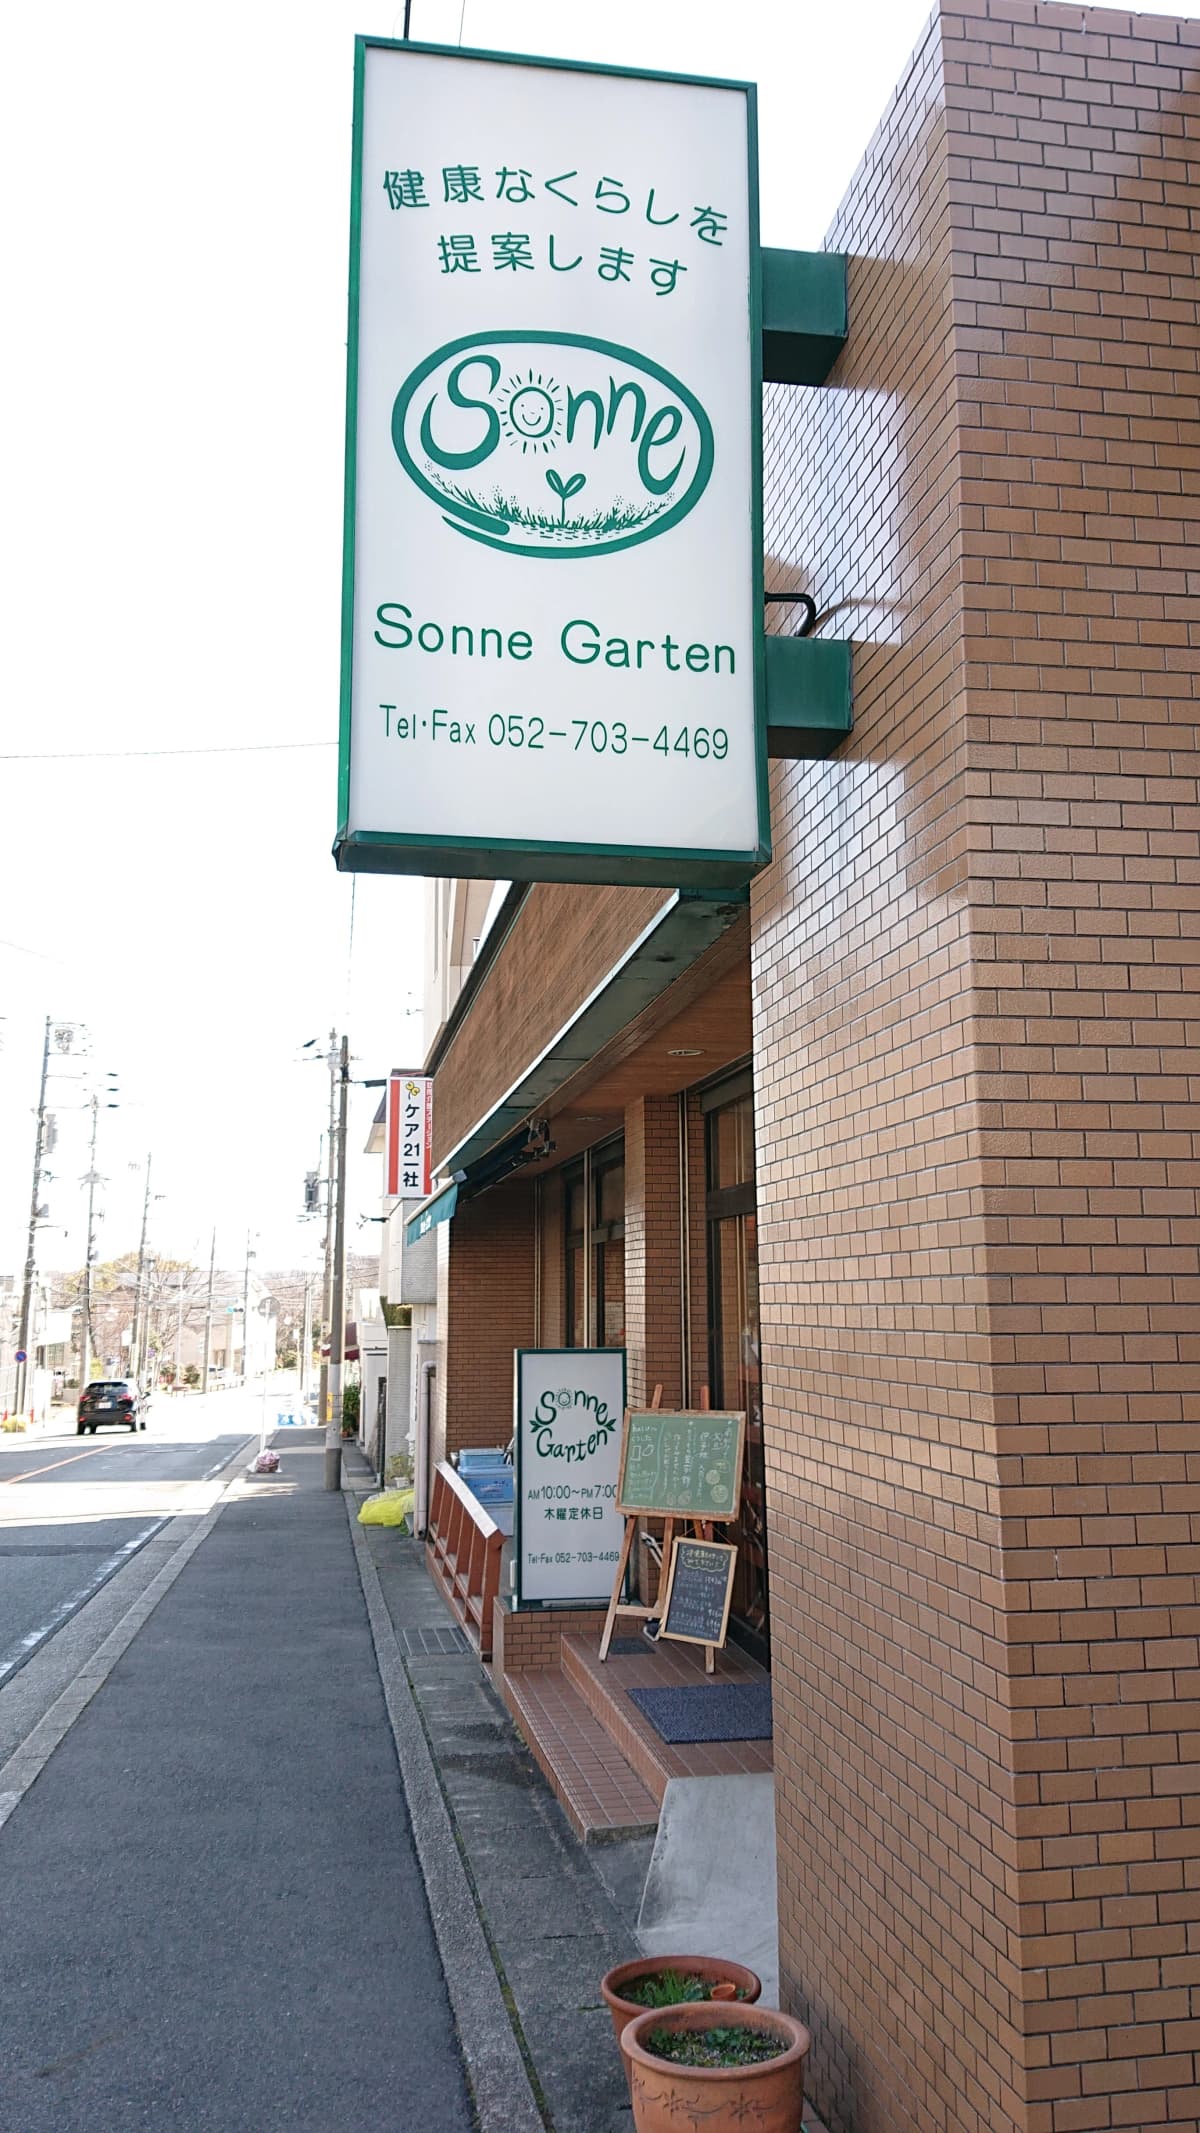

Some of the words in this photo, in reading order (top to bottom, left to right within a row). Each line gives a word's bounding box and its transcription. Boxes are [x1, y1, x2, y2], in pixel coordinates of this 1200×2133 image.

[382, 164, 729, 247] 健康なくらしを
[436, 231, 688, 297] 提案します
[420, 354, 686, 496] Sonne
[373, 602, 533, 661] Sonne
[560, 619, 736, 675] Garten
[488, 713, 729, 760] 052-703-4469
[403, 1104, 420, 1187] ケア21一社
[535, 1389, 609, 1426] Sonne
[536, 1427, 608, 1463] Garten
[544, 1506, 603, 1520] 木曜定休日
[555, 1551, 620, 1564] 052-703-4469
